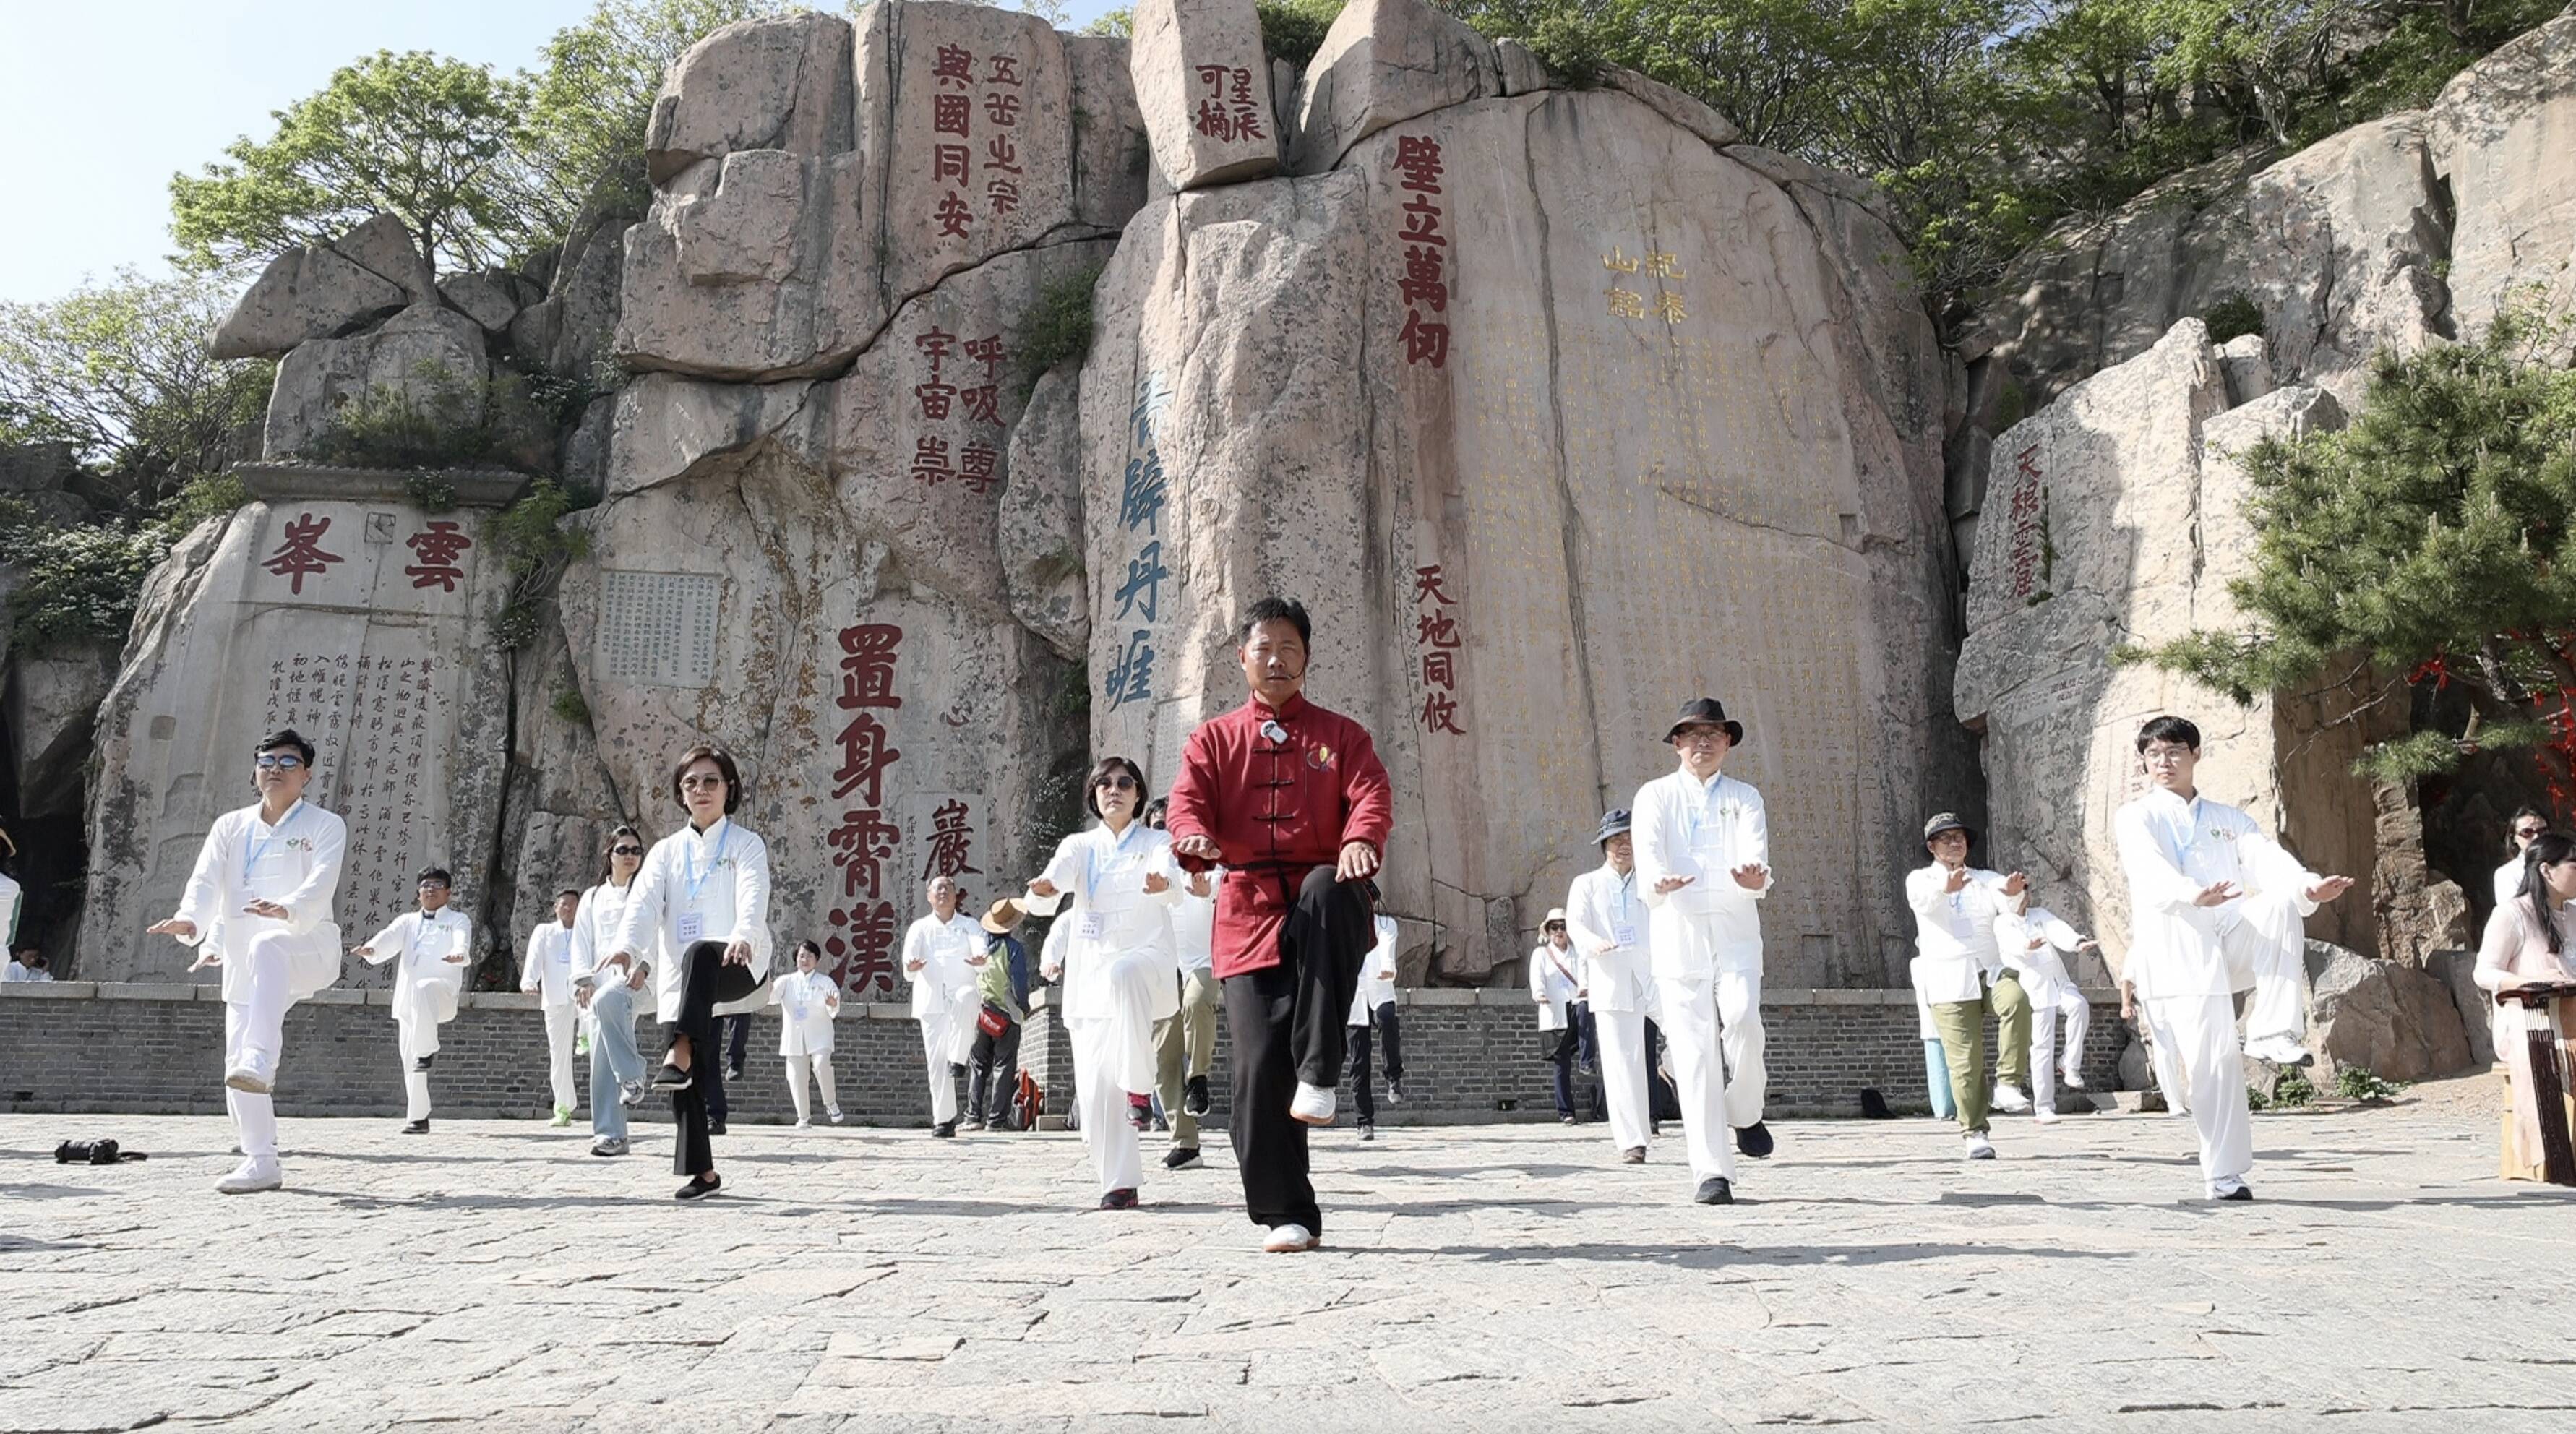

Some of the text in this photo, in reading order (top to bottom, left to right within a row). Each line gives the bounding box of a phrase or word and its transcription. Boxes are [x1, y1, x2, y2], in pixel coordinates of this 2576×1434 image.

[1391, 134, 1451, 369] 壁立萬仞
[1415, 564, 1466, 735] 天地同攸
[825, 623, 902, 994] 置身霄漢
